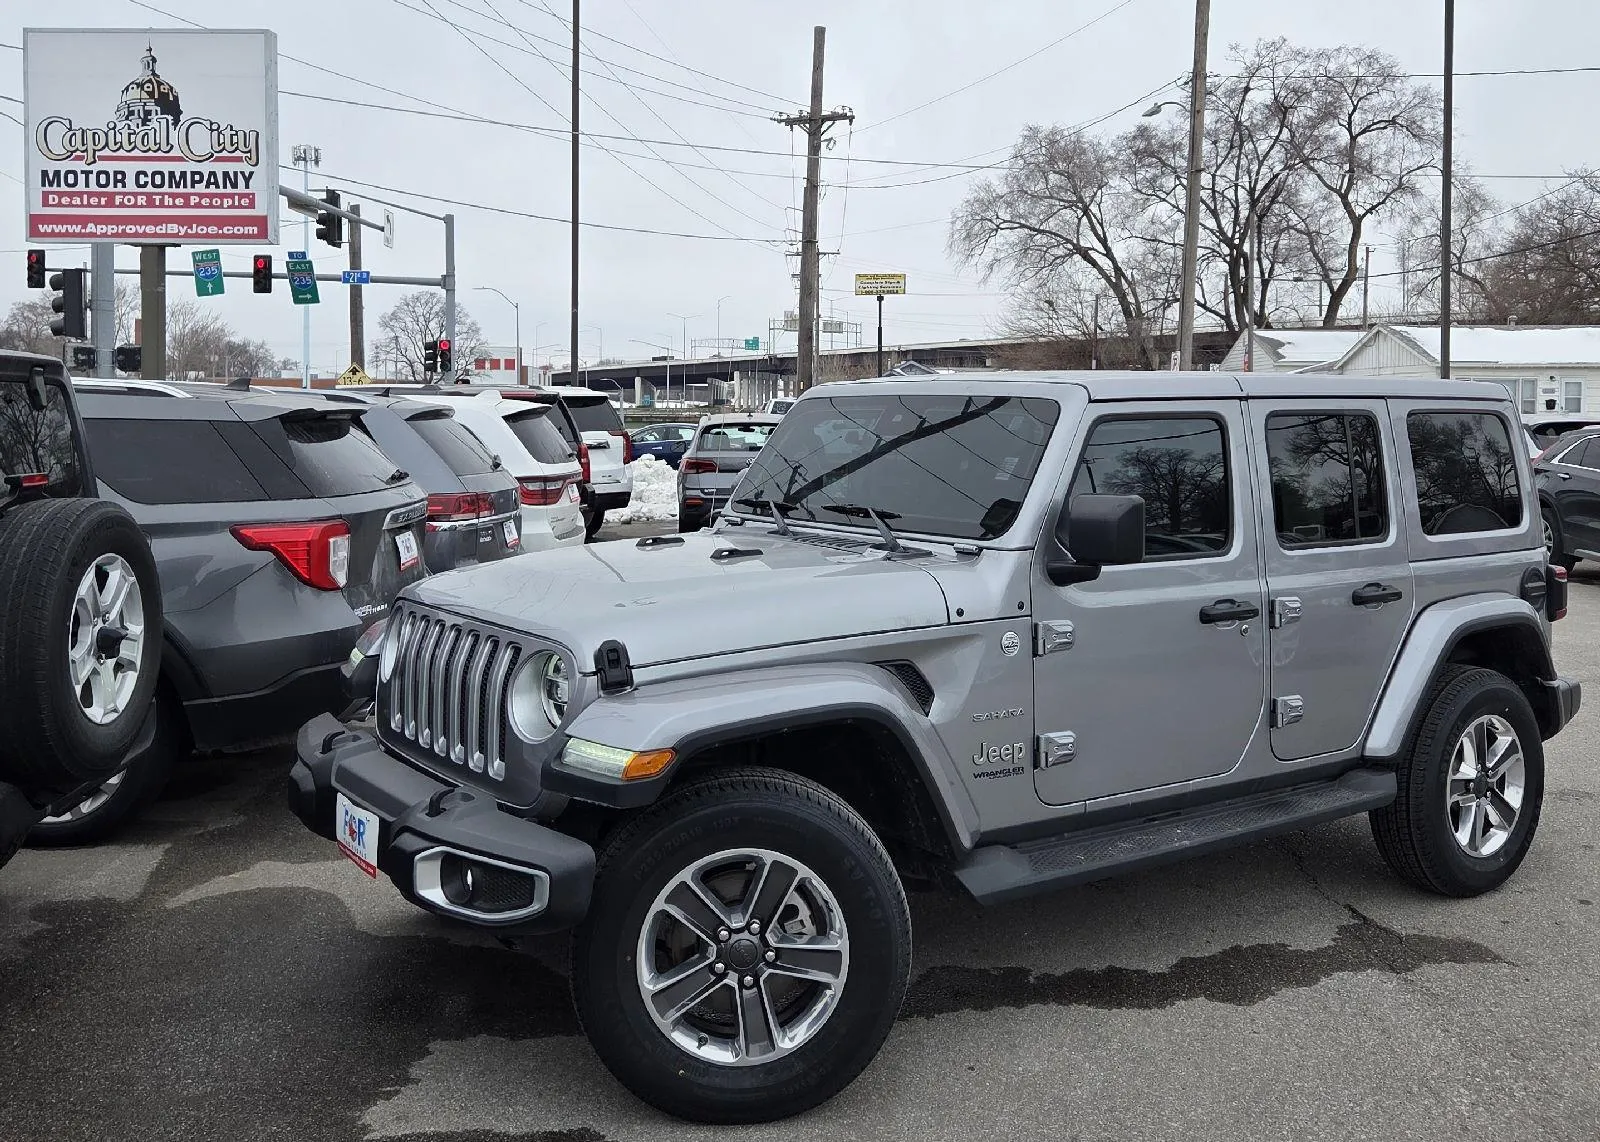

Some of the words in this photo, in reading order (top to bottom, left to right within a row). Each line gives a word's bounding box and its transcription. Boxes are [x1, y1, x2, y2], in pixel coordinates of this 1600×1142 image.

[36, 115, 174, 166] Capital
[177, 116, 260, 167] City
[40, 169, 127, 188] MOTOR
[134, 170, 255, 190] COMPANY
[48, 194, 108, 206] Dealer
[114, 194, 147, 206] FOR
[152, 194, 185, 207] The
[189, 195, 251, 209] People
[38, 222, 259, 236] www.ApprovedByJoe.com
[199, 266, 219, 277] 235
[293, 276, 312, 286] 235
[972, 707, 1025, 723] SAHARA
[972, 741, 1026, 766] Jeep
[973, 766, 1025, 779] WRANGLER
